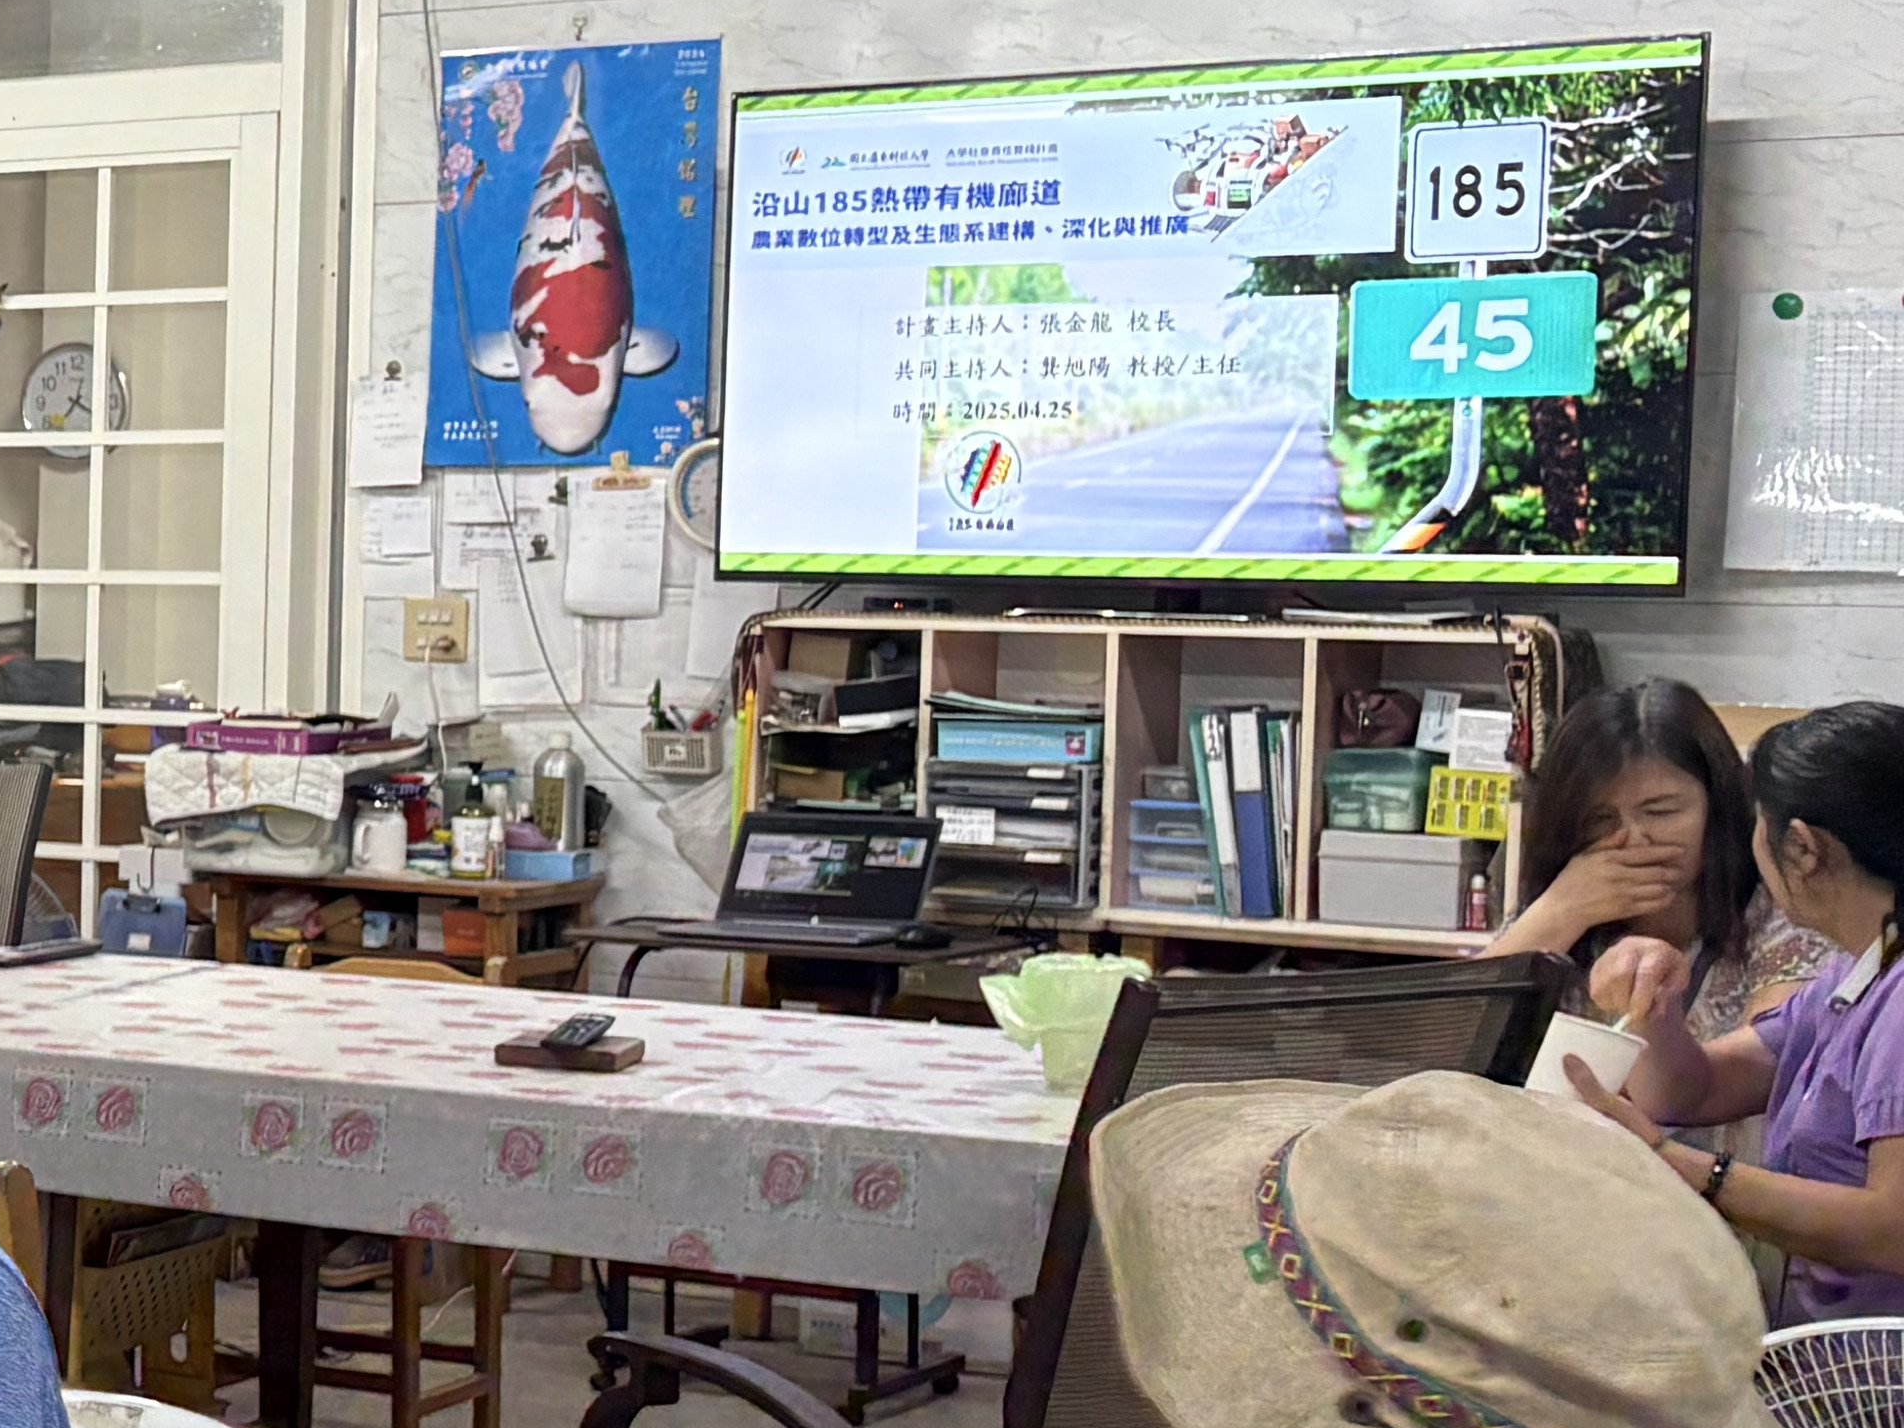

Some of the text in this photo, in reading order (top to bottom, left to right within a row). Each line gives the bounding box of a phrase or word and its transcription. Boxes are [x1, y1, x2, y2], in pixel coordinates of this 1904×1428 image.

[752, 178, 1062, 218] 沿山185熱帶有機廊道
[1429, 161, 1526, 221] 185
[1409, 297, 1534, 375] 45
